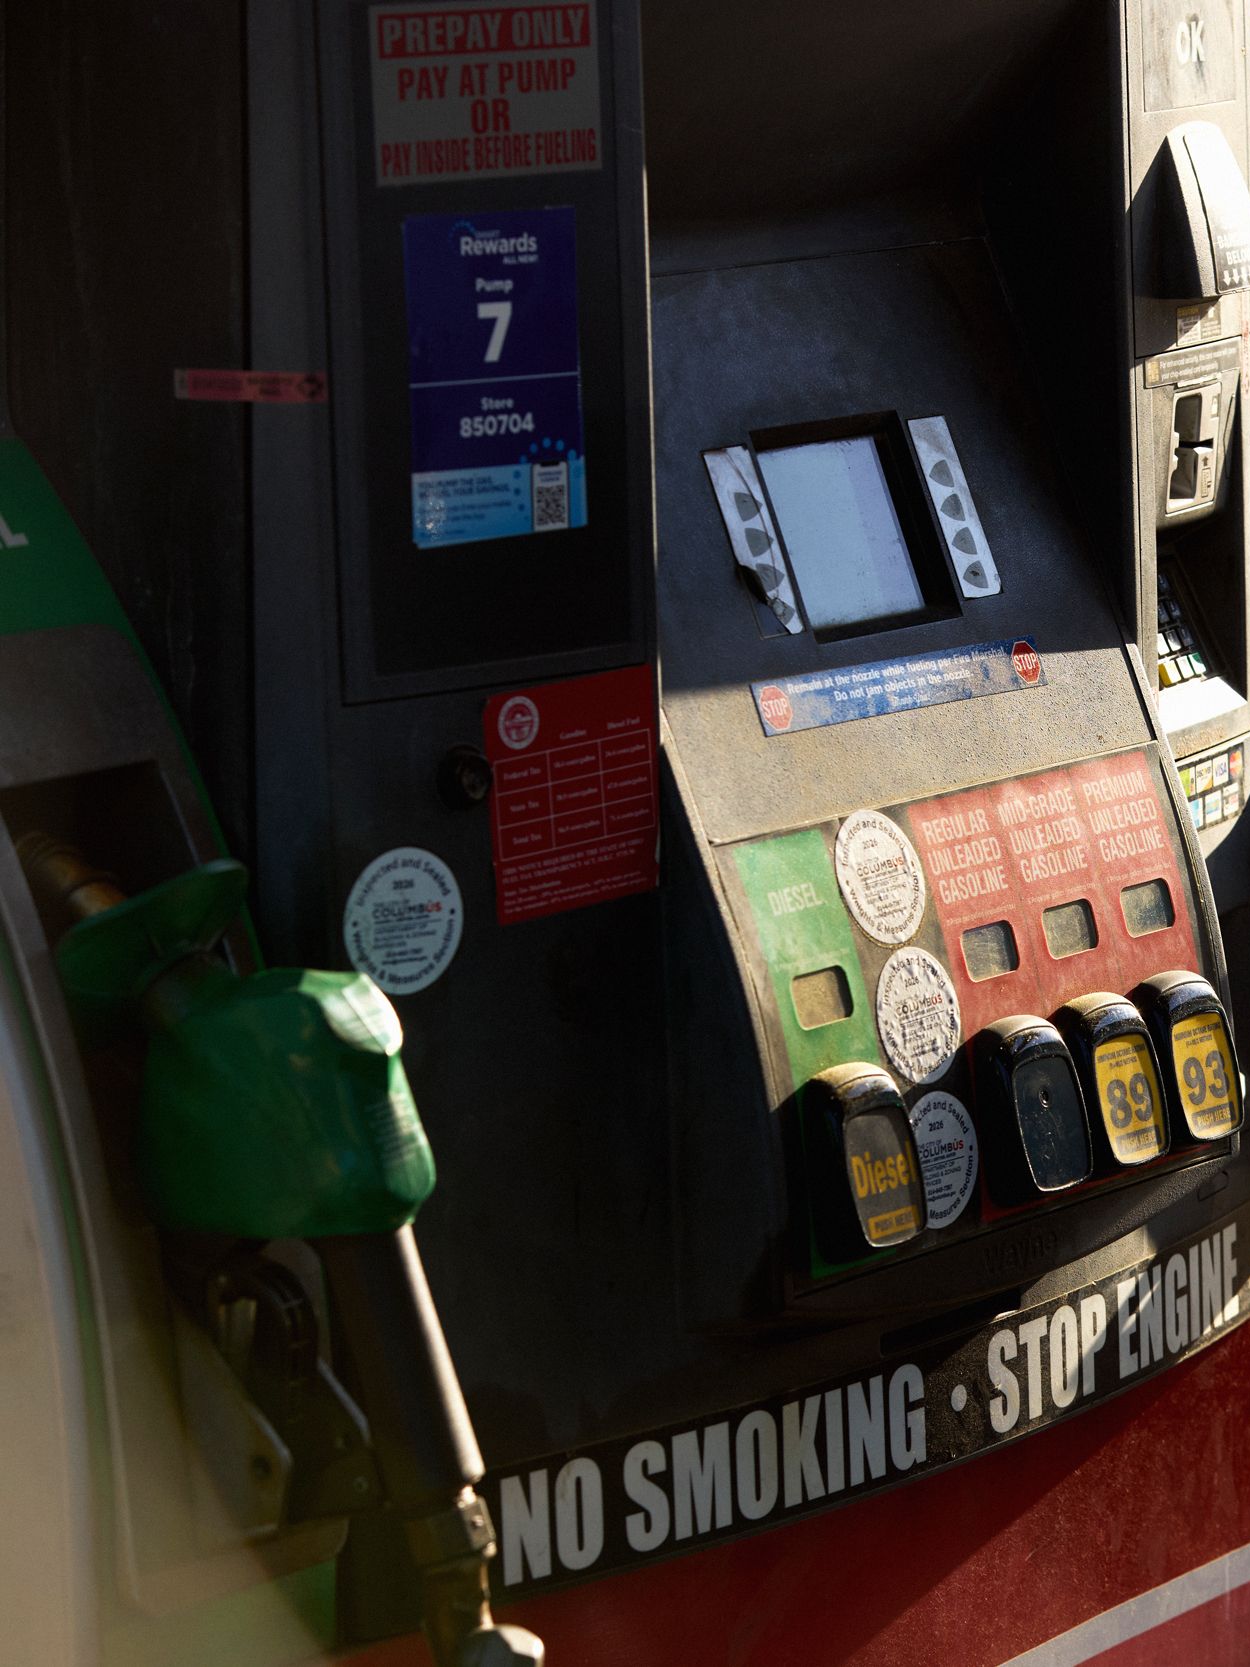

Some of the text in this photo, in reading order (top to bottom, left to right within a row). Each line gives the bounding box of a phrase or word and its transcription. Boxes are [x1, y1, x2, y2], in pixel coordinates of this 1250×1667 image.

[382, 7, 585, 55] PREPAY ONLY
[1176, 20, 1206, 64] OK
[397, 58, 576, 101] PAY AT PUMP
[470, 98, 511, 133] OR
[381, 128, 597, 177] PAY INSIDE BEFORE FUELING
[460, 232, 538, 256] Rewards
[475, 277, 514, 294] Pump
[477, 301, 512, 363] 7
[480, 397, 513, 411] Store
[460, 412, 534, 438] 850704
[787, 682, 823, 694] Remain
[824, 677, 833, 687] at
[834, 675, 849, 686] the
[852, 669, 880, 684] nozzle
[881, 664, 905, 678] while
[906, 659, 937, 674] fueling
[937, 657, 953, 671] per
[954, 652, 970, 666] Fire
[1013, 654, 1038, 672] STOP
[834, 668, 974, 702] Do not jam objects in the nozzle.
[762, 697, 788, 717] STOP
[1083, 770, 1147, 806] PREMIUM
[1215, 762, 1227, 778] VISA
[998, 787, 1076, 826] MID-GRADE
[1089, 797, 1158, 835] UNLEADED
[862, 819, 877, 829] and
[878, 821, 906, 850] Sealed
[862, 838, 879, 850] 2026
[922, 808, 990, 845] REGULAR
[1009, 816, 1081, 855] UNLEADED
[1099, 825, 1164, 863] GASOLINE
[856, 856, 905, 878] COLUMBUS
[927, 837, 1002, 876] UNLEADED
[1020, 845, 1088, 883] GASOLINE
[401, 858, 421, 870] and
[423, 862, 451, 897] Sealed
[939, 866, 1008, 905] GASOLINE
[372, 901, 443, 919] COLUMBUS
[767, 882, 823, 917] DIESEL
[850, 887, 875, 927] Weights
[884, 913, 914, 935] Measures
[911, 871, 920, 911] Section
[388, 963, 435, 984] Measures
[904, 976, 920, 988] 2026
[906, 955, 921, 966] and
[921, 958, 946, 989] Sealed
[896, 993, 943, 1017] COLUMBUS
[1182, 1050, 1230, 1106] 93
[913, 1100, 970, 1134] ected and Sealed
[1106, 1072, 1153, 1129] 89
[1197, 1109, 1231, 1125] PUSH HERE
[928, 1120, 944, 1132] 2026
[1120, 1130, 1156, 1148] PUSH HERE
[851, 1136, 917, 1200] Diesel
[929, 1197, 961, 1220] Measures
[959, 1155, 973, 1197] Section
[987, 1223, 1242, 1435] STOP ENGINE
[499, 1361, 928, 1587] NO SMOKING
